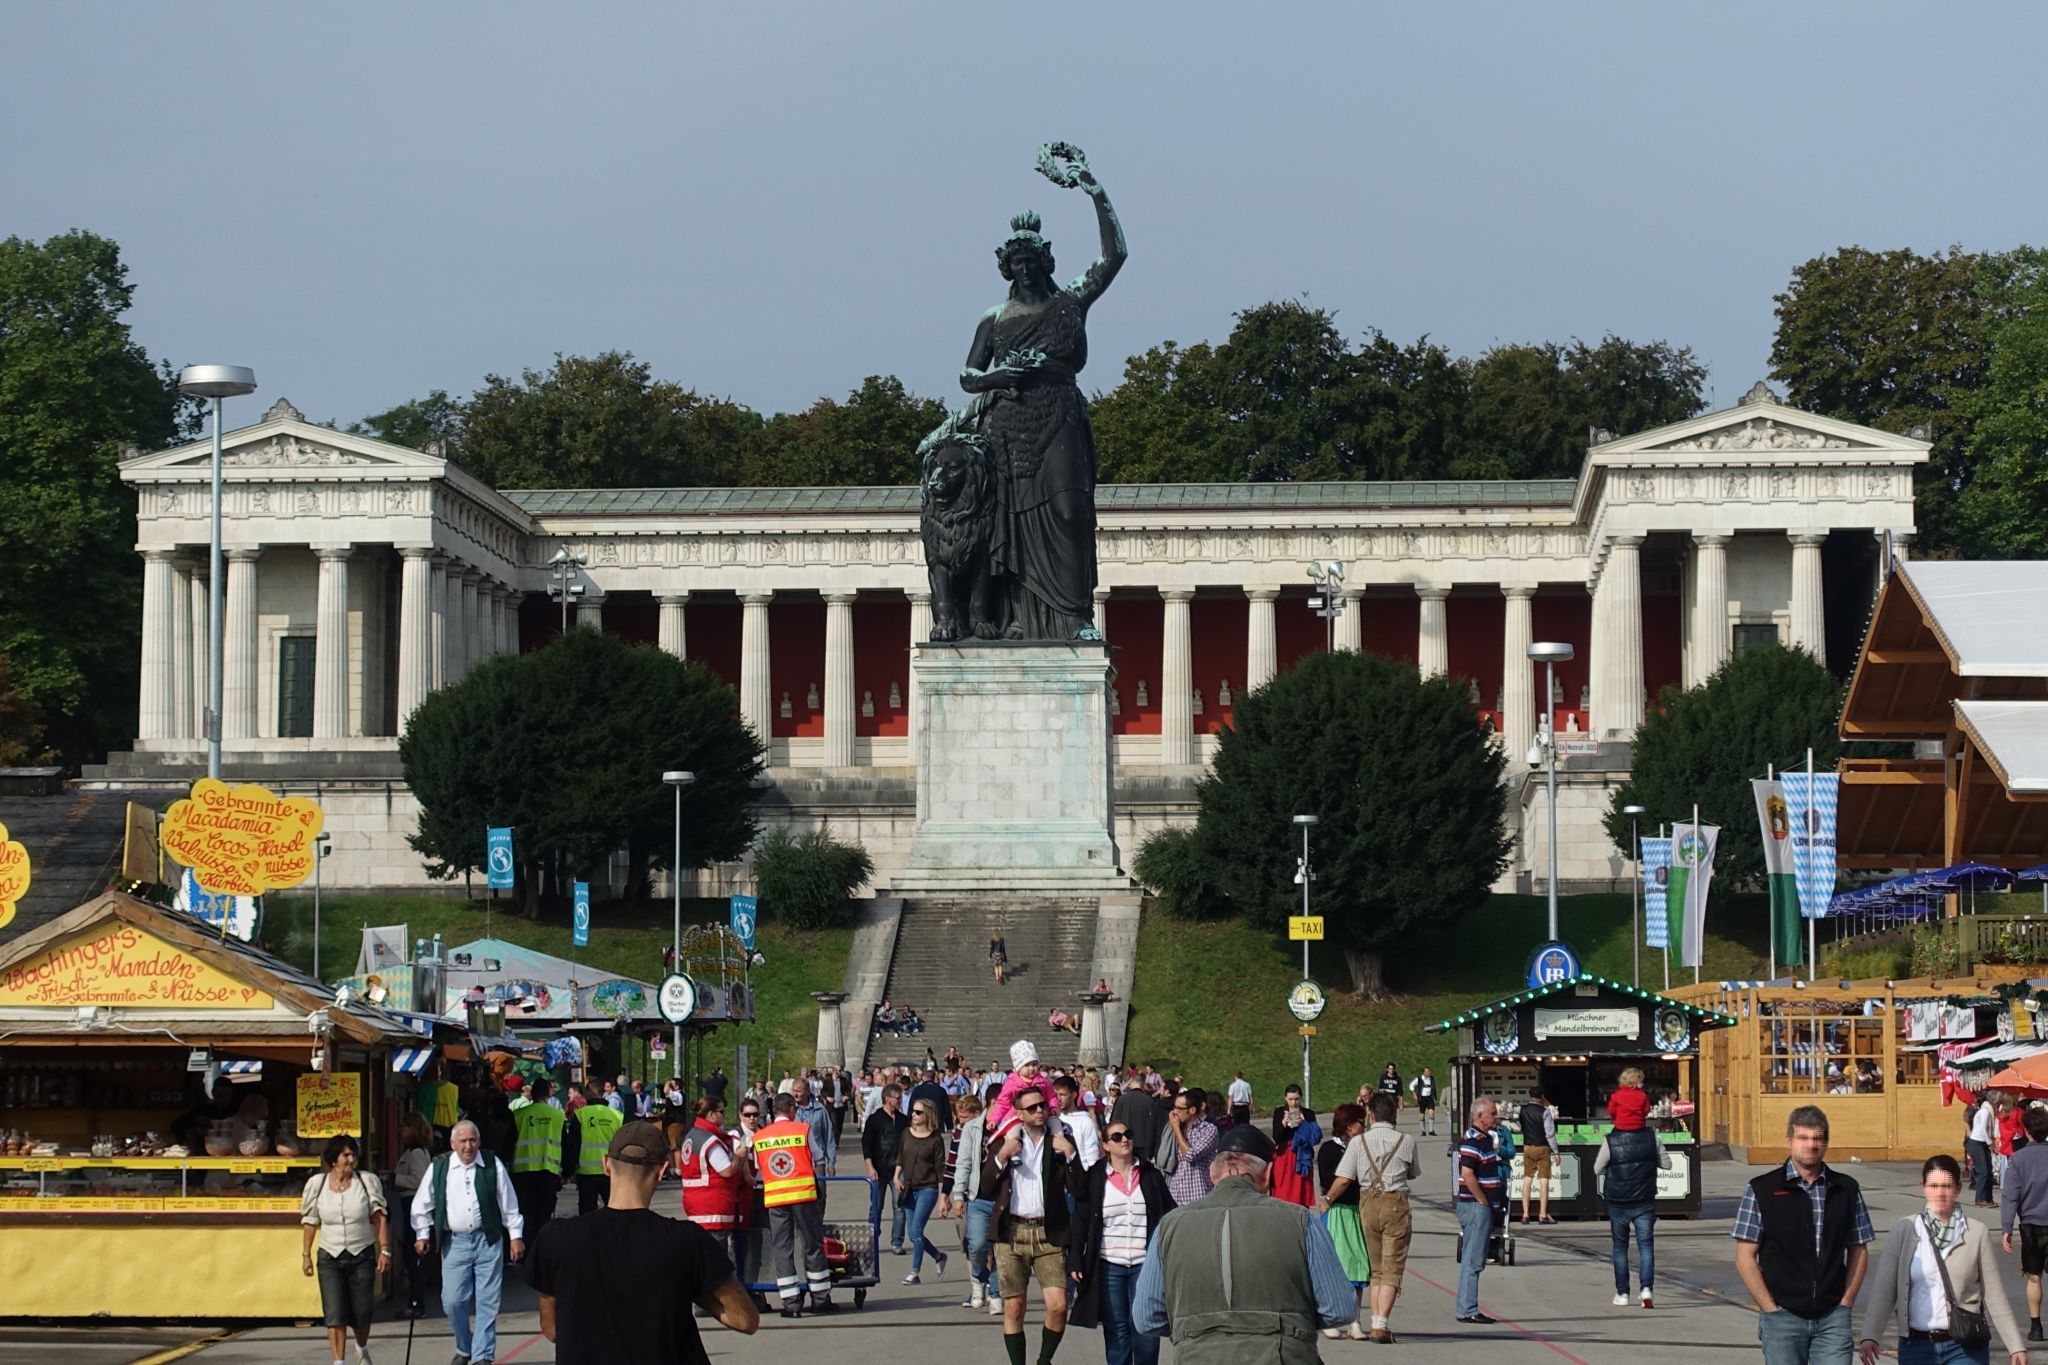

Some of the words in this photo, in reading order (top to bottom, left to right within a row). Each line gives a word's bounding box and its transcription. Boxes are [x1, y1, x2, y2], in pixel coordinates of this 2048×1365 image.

[203, 789, 293, 817] Gebrannte
[173, 804, 275, 835] Macadamia
[166, 829, 236, 876] Walnüsse
[207, 832, 250, 857] Cocos
[1301, 922, 1322, 934] TAXI
[105, 951, 195, 979] Mandeln
[162, 979, 229, 1001] Nüsse
[1554, 1024, 1620, 1033] Mandelbrennerei
[1567, 1013, 1607, 1021] Münchner
[758, 1138, 790, 1149] TEAM
